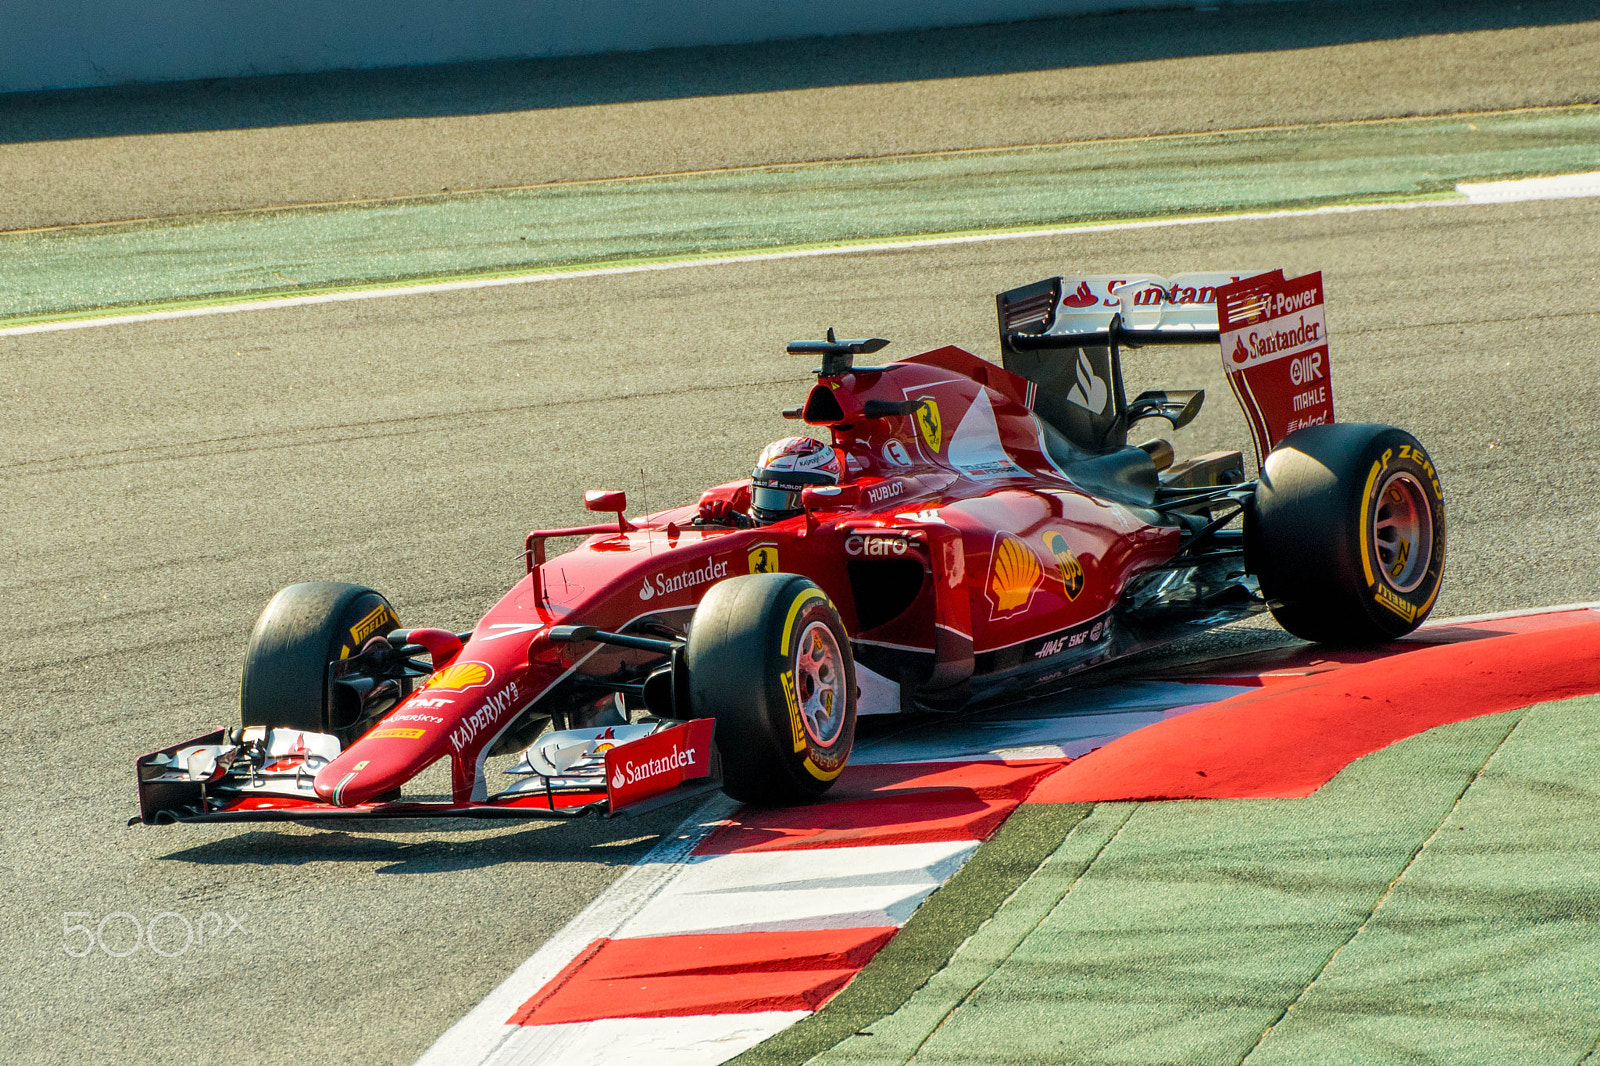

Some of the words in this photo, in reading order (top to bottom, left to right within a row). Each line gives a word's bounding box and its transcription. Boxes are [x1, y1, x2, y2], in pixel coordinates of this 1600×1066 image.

[1103, 277, 1240, 307] Sntan
[1249, 315, 1320, 359] Santander
[1293, 386, 1326, 412] MAHLE
[868, 481, 904, 503] HUBLOT
[1381, 448, 1393, 469] P
[1399, 445, 1444, 500] ZERO
[845, 535, 908, 556] Claro
[656, 556, 728, 596] Santander
[1374, 582, 1418, 624] PIRELLI
[350, 604, 389, 646] PIRELLI
[1068, 631, 1089, 647] SKF
[406, 698, 456, 708] TNT
[449, 685, 513, 752] KASPERSKY
[626, 744, 696, 784] Santander
